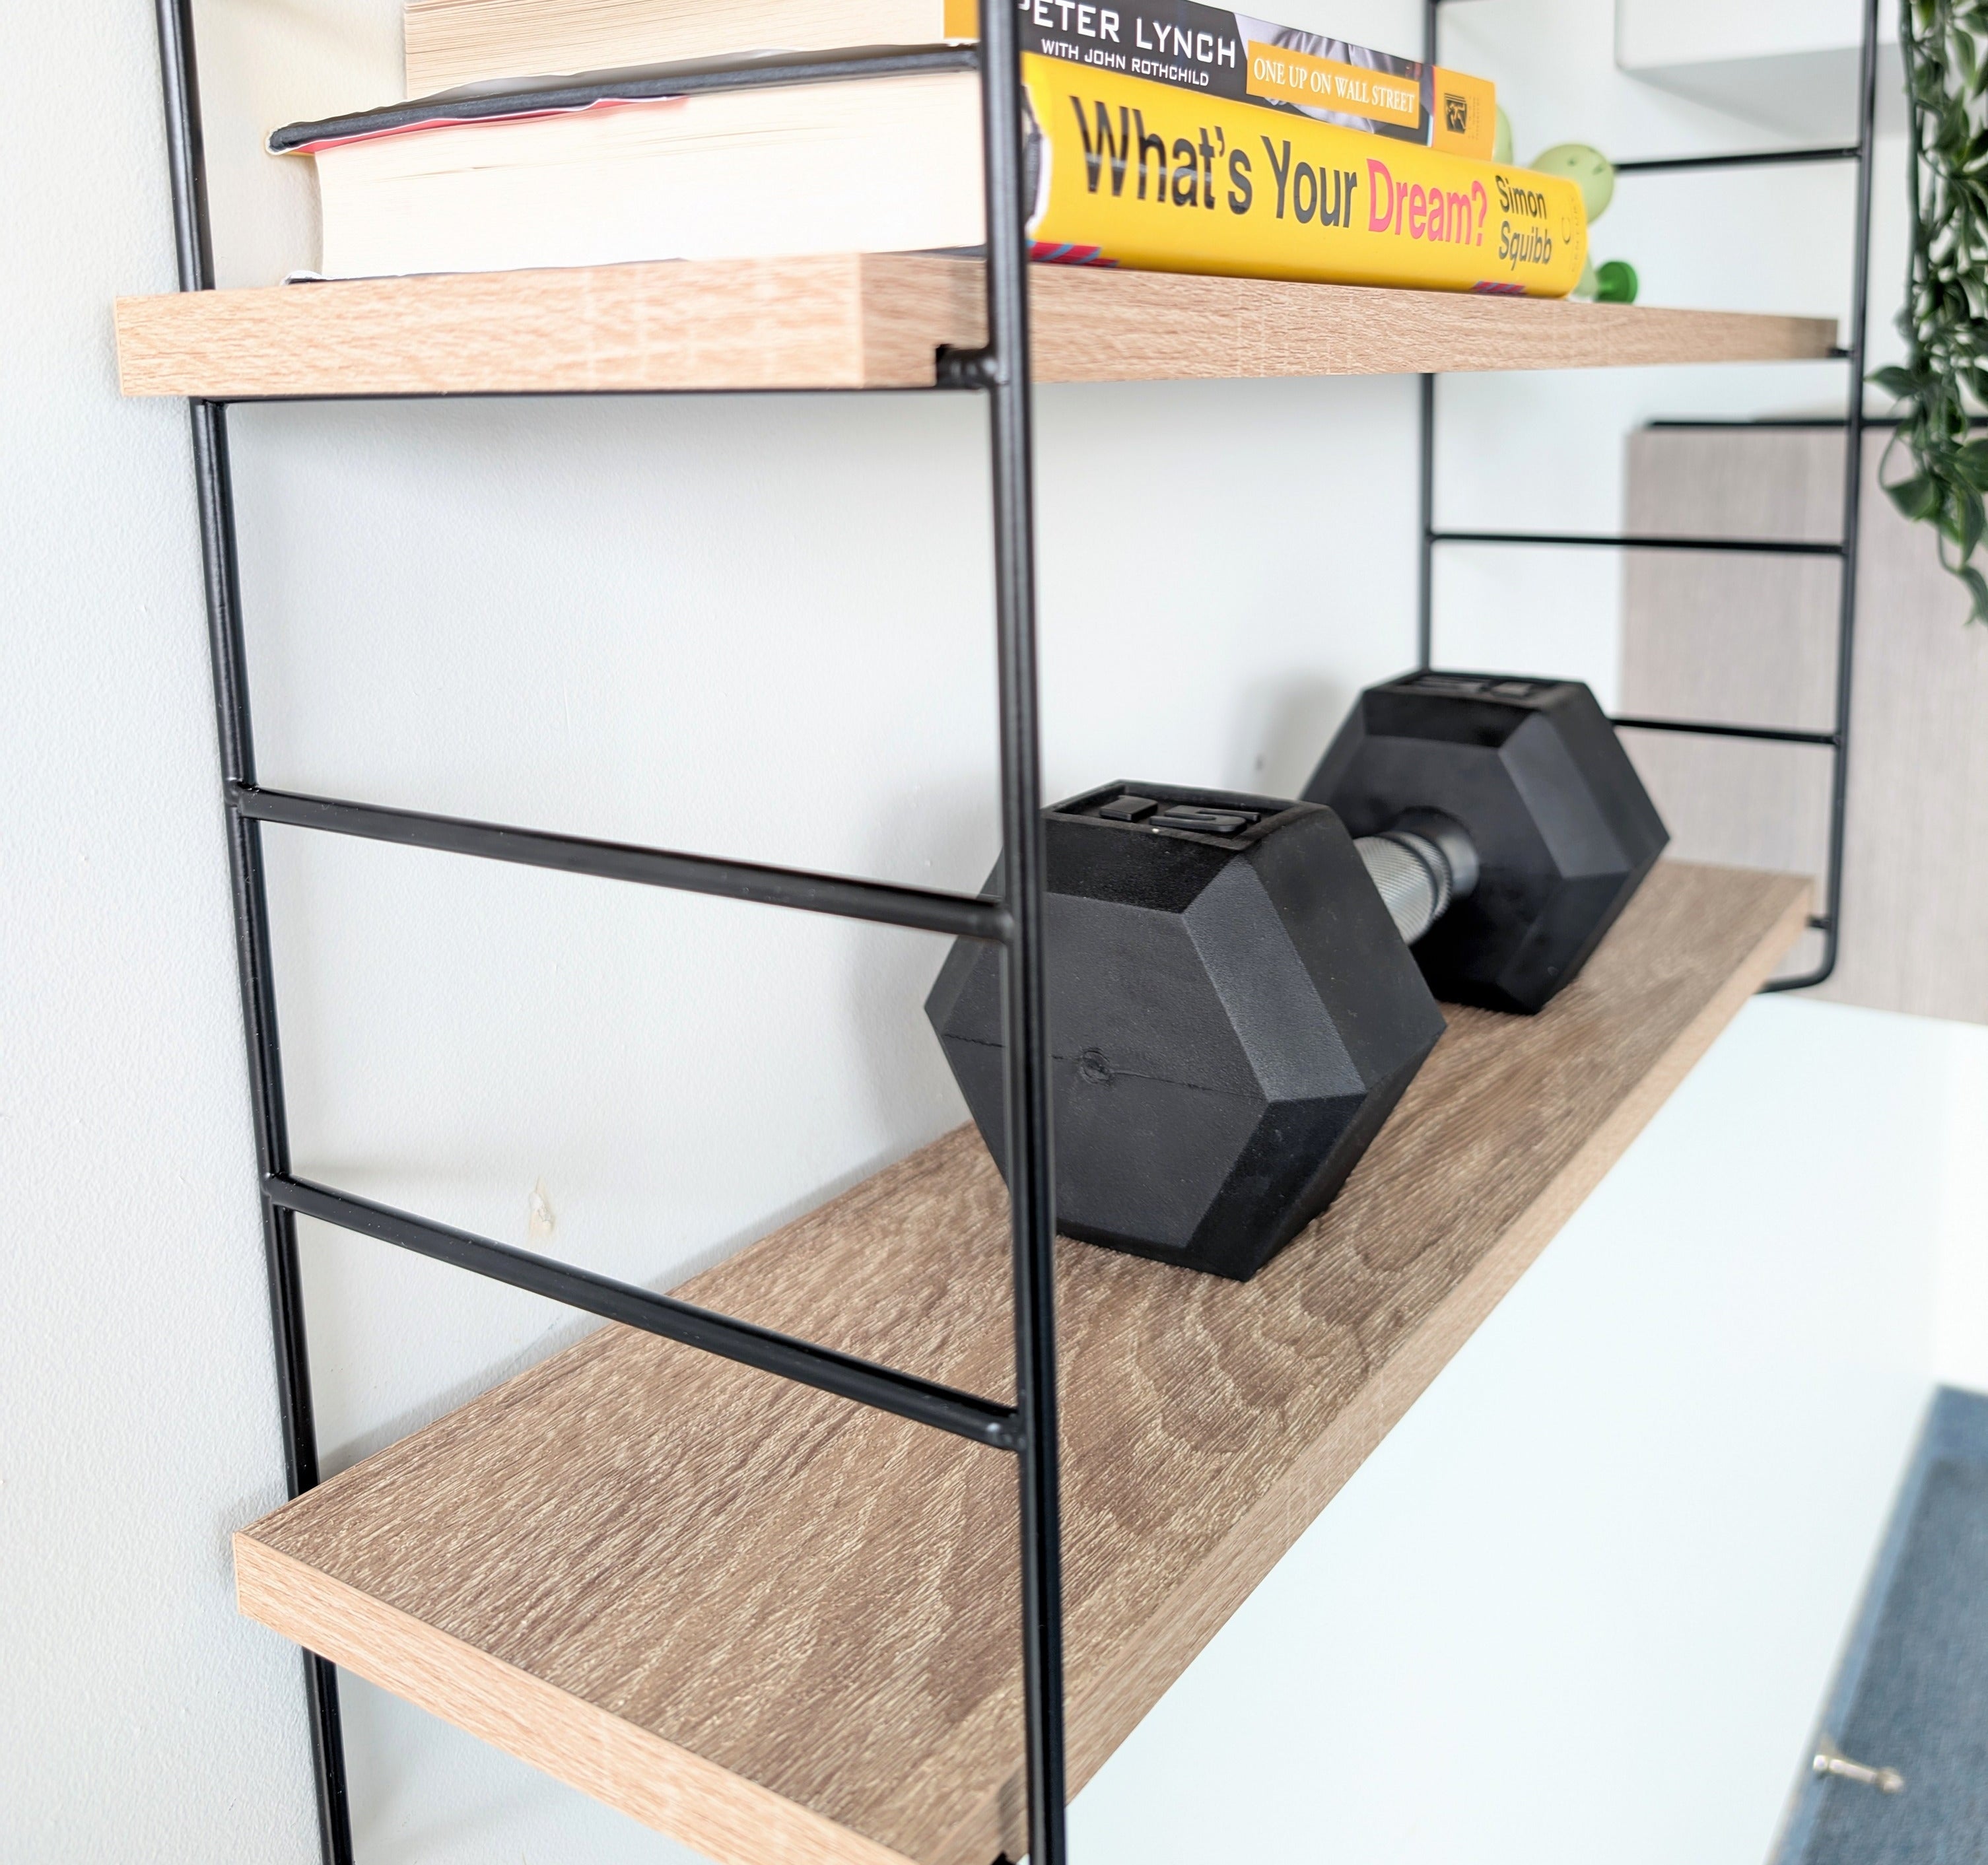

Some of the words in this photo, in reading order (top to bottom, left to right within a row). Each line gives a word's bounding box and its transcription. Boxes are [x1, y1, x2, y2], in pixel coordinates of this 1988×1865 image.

[1041, 38, 1080, 60] WITH
[1084, 49, 1126, 69] JOHN
[1131, 58, 1209, 86] ROTHCHILD
[1136, 17, 1236, 68] LYNCH
[1254, 57, 1285, 85] ONE
[1289, 67, 1307, 90] UP
[1310, 71, 1332, 96] ON
[1335, 77, 1369, 104] WALL
[1371, 85, 1415, 114] STREET
[1069, 95, 1252, 215] What’s
[1260, 135, 1357, 228] Your
[1367, 158, 1488, 246] Dream?
[1495, 174, 1547, 220] Simon
[1498, 220, 1552, 271] Squibb
[1099, 795, 1261, 833] 15
